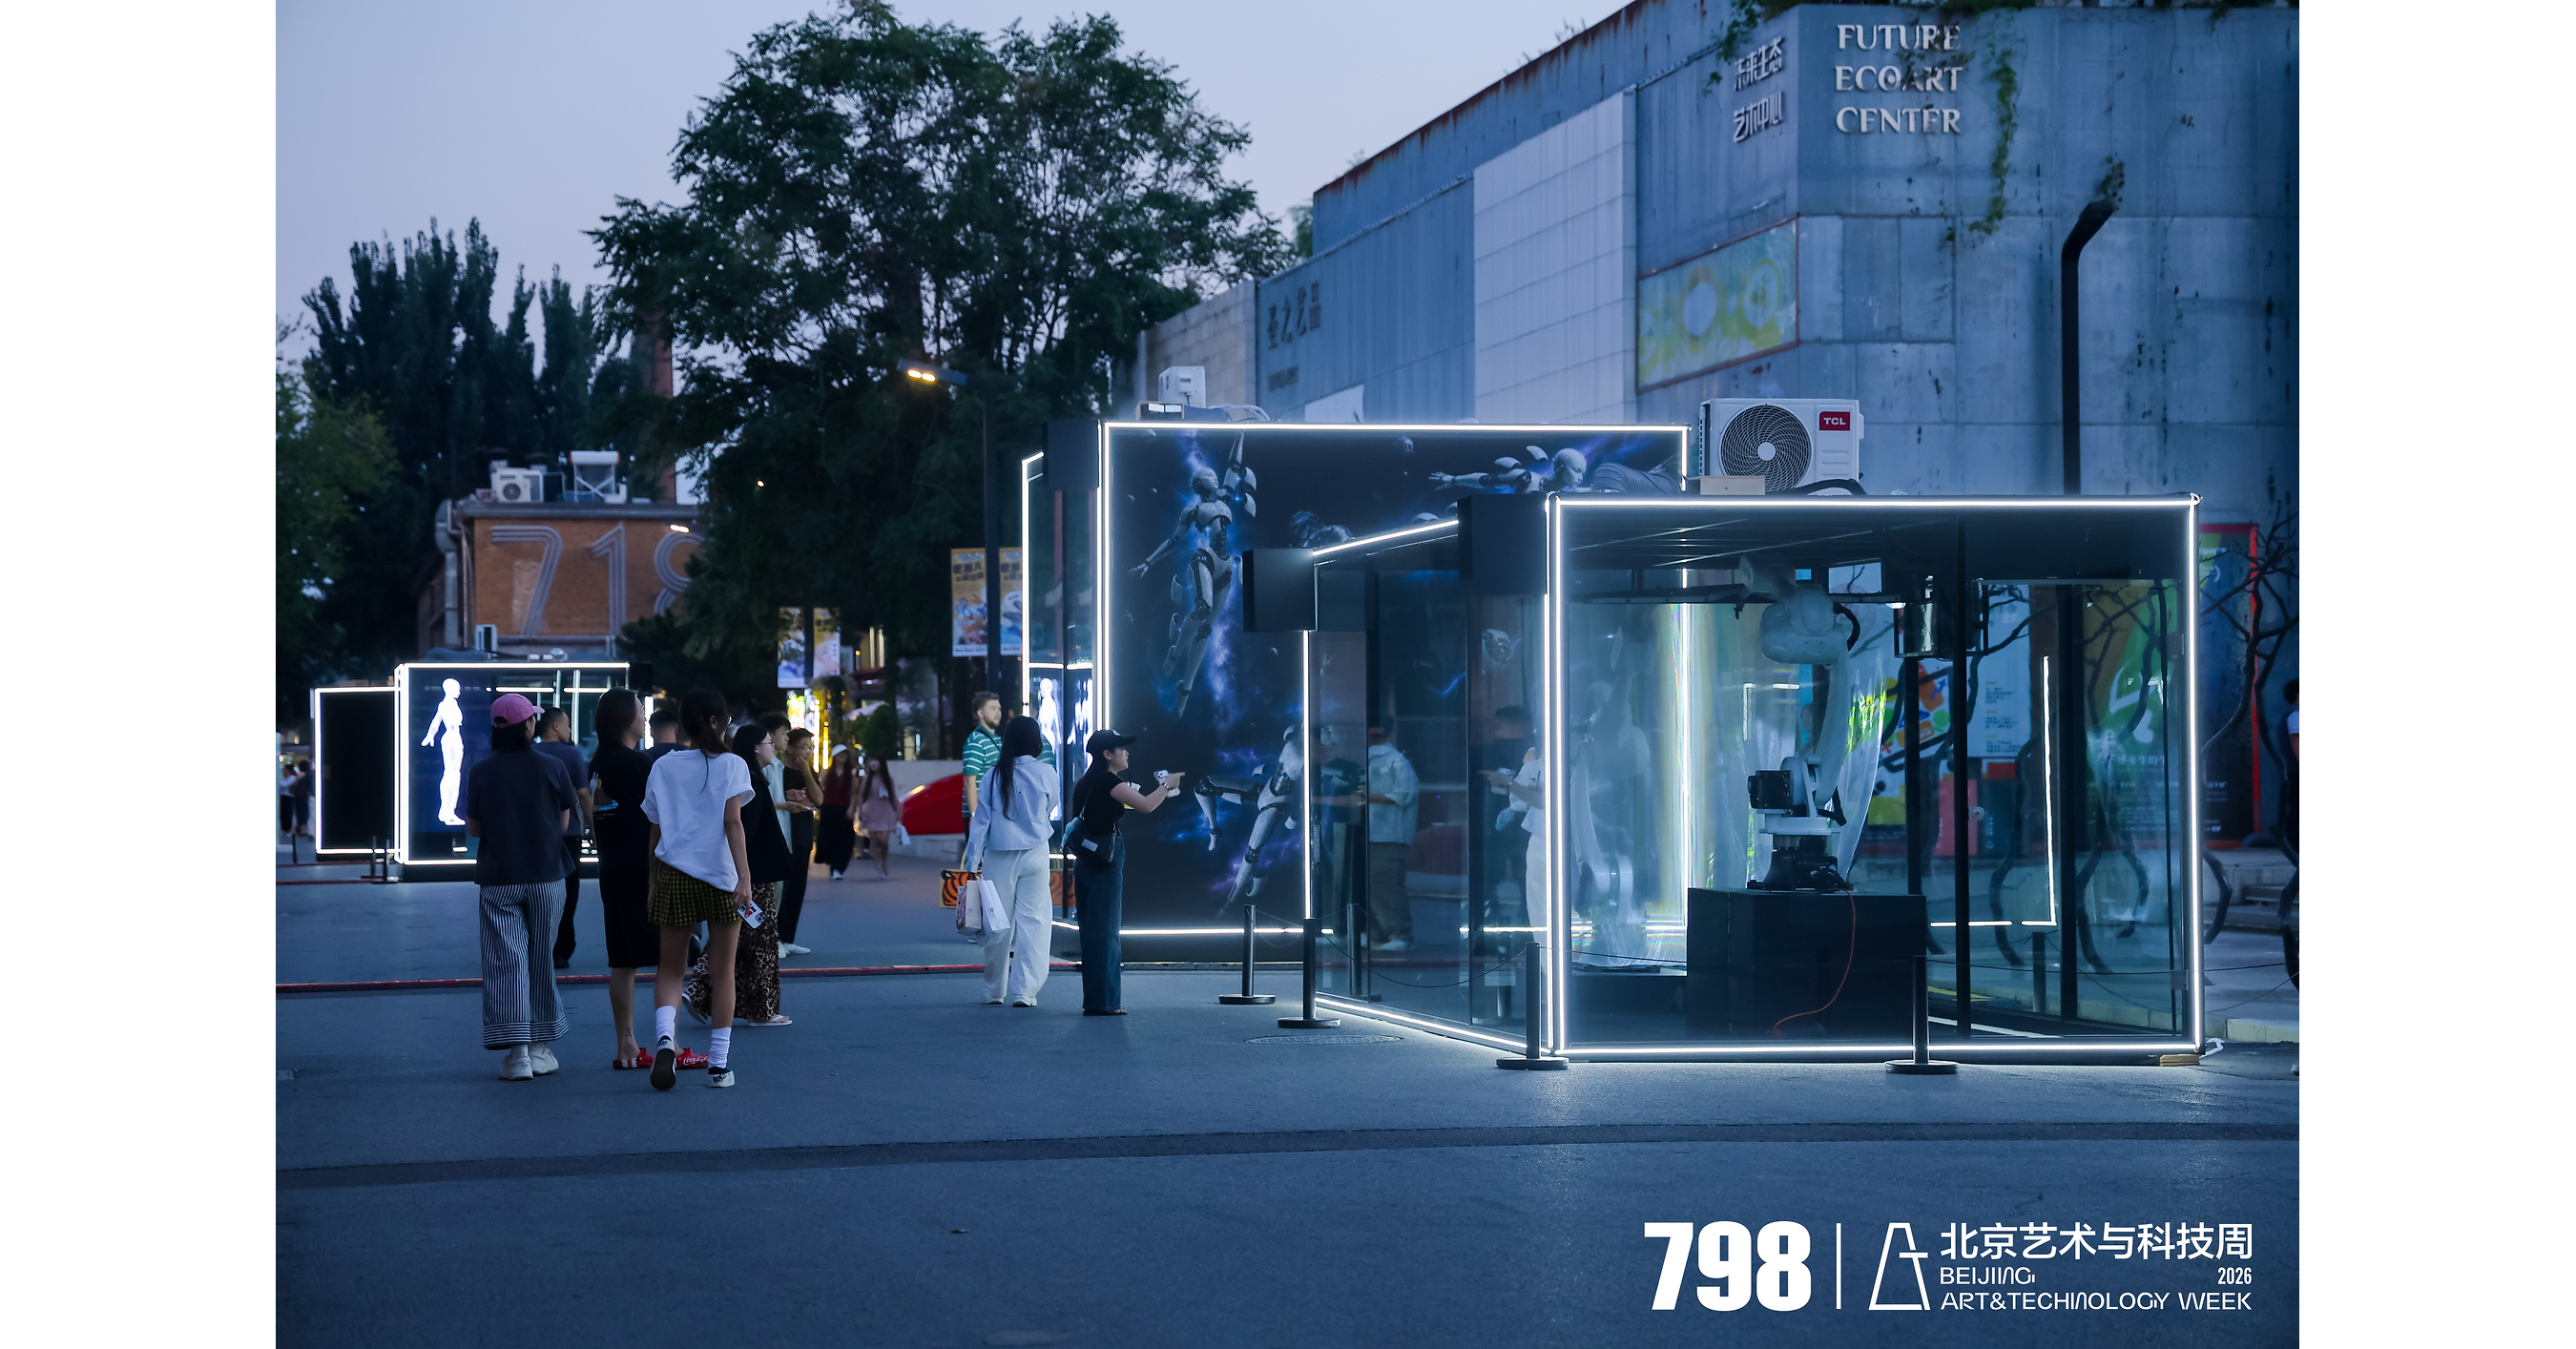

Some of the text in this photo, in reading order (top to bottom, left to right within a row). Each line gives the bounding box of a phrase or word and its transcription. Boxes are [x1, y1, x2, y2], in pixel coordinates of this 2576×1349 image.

[1837, 24, 1962, 51] FUTURE
[1733, 36, 1783, 91] 未来生态
[1733, 92, 1783, 142] 艺术中心
[1836, 106, 1962, 133] CENTER
[1823, 417, 1846, 425] TCL
